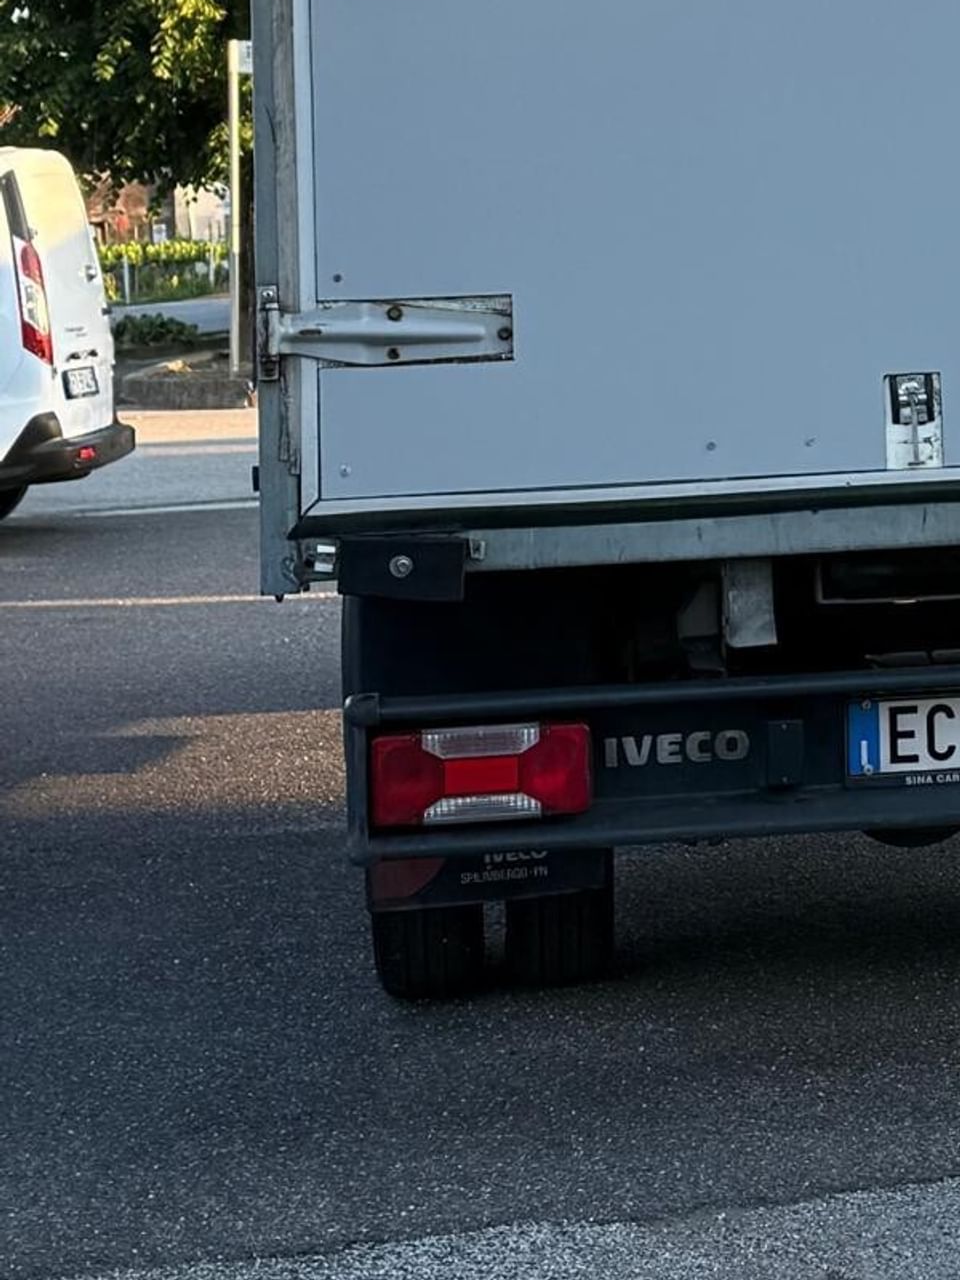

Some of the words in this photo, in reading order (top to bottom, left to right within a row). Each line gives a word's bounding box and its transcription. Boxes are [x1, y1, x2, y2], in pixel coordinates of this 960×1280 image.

[603, 729, 750, 768] IVECO
[889, 702, 956, 766] EC
[905, 775, 933, 785] SINA
